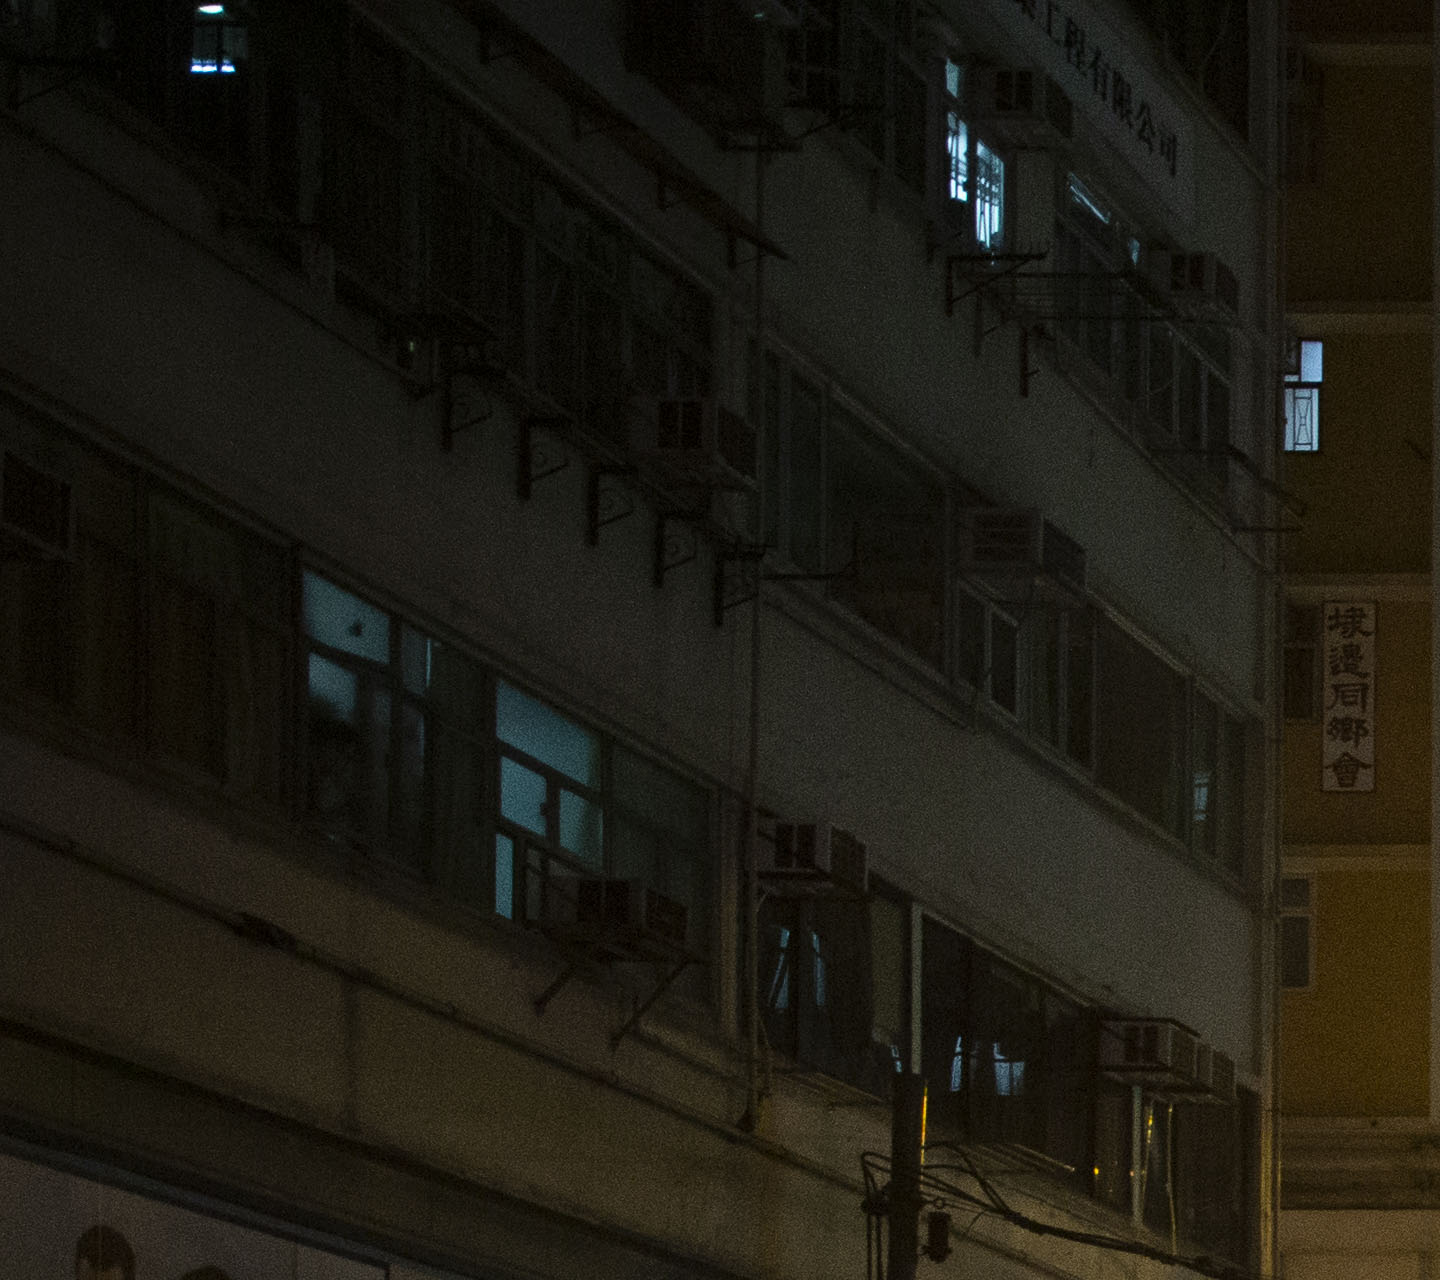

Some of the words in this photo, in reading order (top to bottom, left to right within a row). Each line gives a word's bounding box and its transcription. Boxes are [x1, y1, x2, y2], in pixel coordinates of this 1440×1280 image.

[1014, 0, 1177, 177] 工程有限公司
